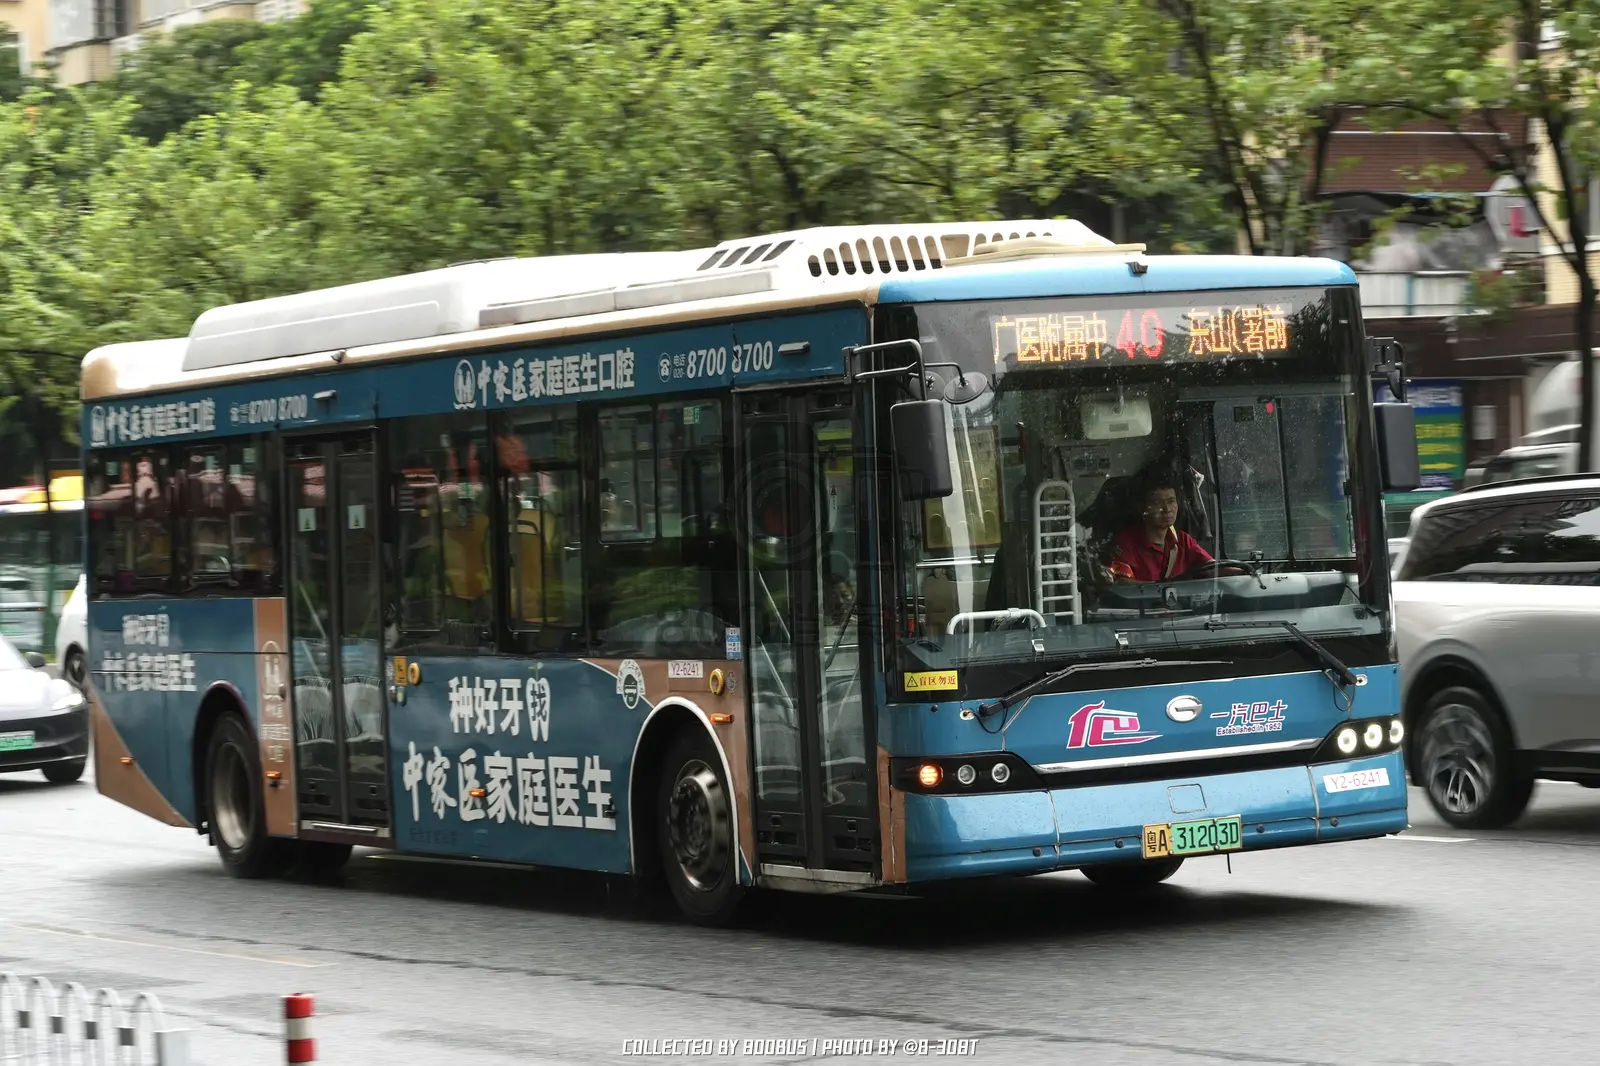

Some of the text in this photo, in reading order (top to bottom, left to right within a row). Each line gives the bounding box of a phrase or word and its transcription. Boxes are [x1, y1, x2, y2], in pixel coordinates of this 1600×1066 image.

[1116, 308, 1165, 359] 40
[686, 346, 727, 379] 8700
[671, 662, 700, 676] Y2-6241
[1210, 699, 1288, 726] 一汽巴士
[1216, 725, 1256, 737] Established
[1265, 721, 1282, 732] 1952
[1330, 771, 1381, 790] Y2-6241
[1176, 822, 1239, 849] 31203D
